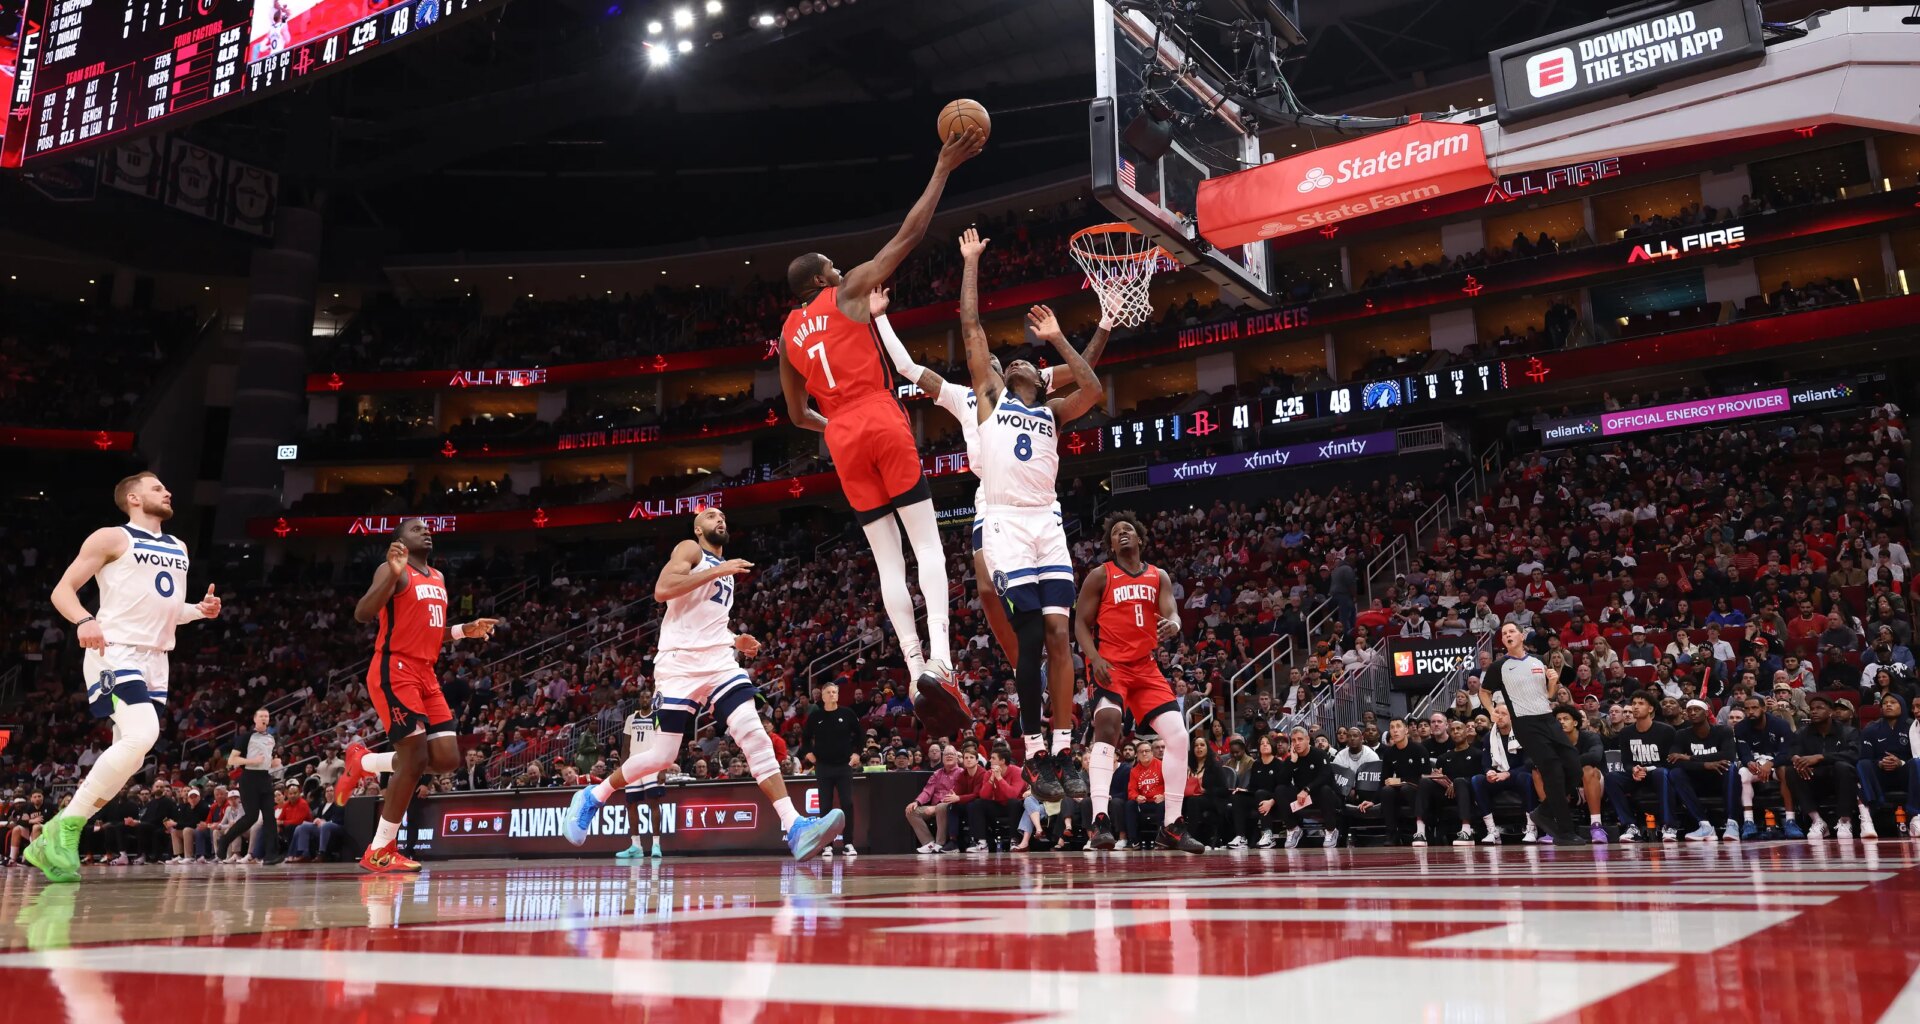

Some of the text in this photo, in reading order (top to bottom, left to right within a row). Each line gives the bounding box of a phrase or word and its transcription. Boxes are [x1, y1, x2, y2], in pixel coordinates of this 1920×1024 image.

[50, 11, 82, 34] 30 CAPELA
[53, 4, 60, 17] 15
[44, 51, 54, 65] 20
[54, 43, 78, 62] OKOGIE
[142, 19, 146, 32] 1
[178, 5, 184, 19] 1
[49, 36, 54, 49] 7
[57, 26, 82, 46] DURANT
[144, 2, 150, 16] 2
[174, 20, 223, 50] FOUR FACTORS
[322, 35, 338, 64] 41
[352, 20, 378, 48] 4:25
[390, 6, 410, 36] 48
[1579, 10, 1696, 62] DOWNLOAD
[16, 20, 41, 102] ALL FIRE
[154, 52, 172, 70] EFG%
[250, 50, 290, 78] TOL FLS CC
[1582, 26, 1724, 85] THE ESPN APP
[66, 61, 106, 86] TEAM STATS
[148, 69, 170, 88] OREB%
[252, 66, 286, 92] 5 2 1
[66, 86, 76, 102] 24
[86, 79, 99, 95] AST
[114, 72, 120, 86] 7
[154, 86, 168, 102] FTR
[41, 86, 118, 122] STL 2 BLK 2
[148, 102, 165, 120] TOV%
[40, 122, 48, 136] TO
[82, 106, 103, 124] BENCH
[110, 100, 118, 116] 17
[36, 135, 54, 152] POSS
[1485, 156, 1621, 204] ALL FIRE
[1628, 226, 1746, 263] ALL FIRE
[792, 316, 829, 348] DURANT
[1178, 306, 1310, 349] HOUSTON ROCKETS
[449, 369, 546, 386] ALL FIRE
[806, 341, 837, 390] 7
[1424, 366, 1490, 386] TOL FLS CC
[1428, 376, 1488, 400] 6 2 1
[1793, 387, 1838, 404] reliant
[1232, 404, 1249, 430] 41
[1275, 396, 1305, 418] 4:25
[1330, 388, 1351, 414] 48
[1546, 394, 1784, 439] reliant OFFICIAL ENERGY PROVIDER
[558, 425, 661, 450] HOUSTON ROCKETS
[996, 414, 1054, 438] WOLVES
[1112, 418, 1164, 436] TOL FLS CC
[1114, 428, 1162, 448] 5 2 1
[1014, 433, 1033, 462] 8
[1174, 438, 1367, 480] xfinity xfinity xfinity
[628, 501, 673, 519] ALL
[348, 517, 395, 534] ALL
[133, 552, 188, 572] WOLVES
[154, 570, 175, 598] 0
[710, 580, 732, 607] 27
[1113, 584, 1157, 605] ROCKETS
[428, 604, 444, 628] 30
[1134, 604, 1144, 627] 8
[1415, 646, 1474, 658] DRAFTKINGS
[1416, 658, 1457, 675] PICK
[632, 724, 653, 732] WOLVES
[636, 731, 645, 742] 11
[1630, 744, 1660, 762] KING
[1358, 772, 1370, 781] GET
[1370, 772, 1382, 782] THE
[418, 828, 434, 840] NOW
[509, 807, 570, 838] ALWAY
